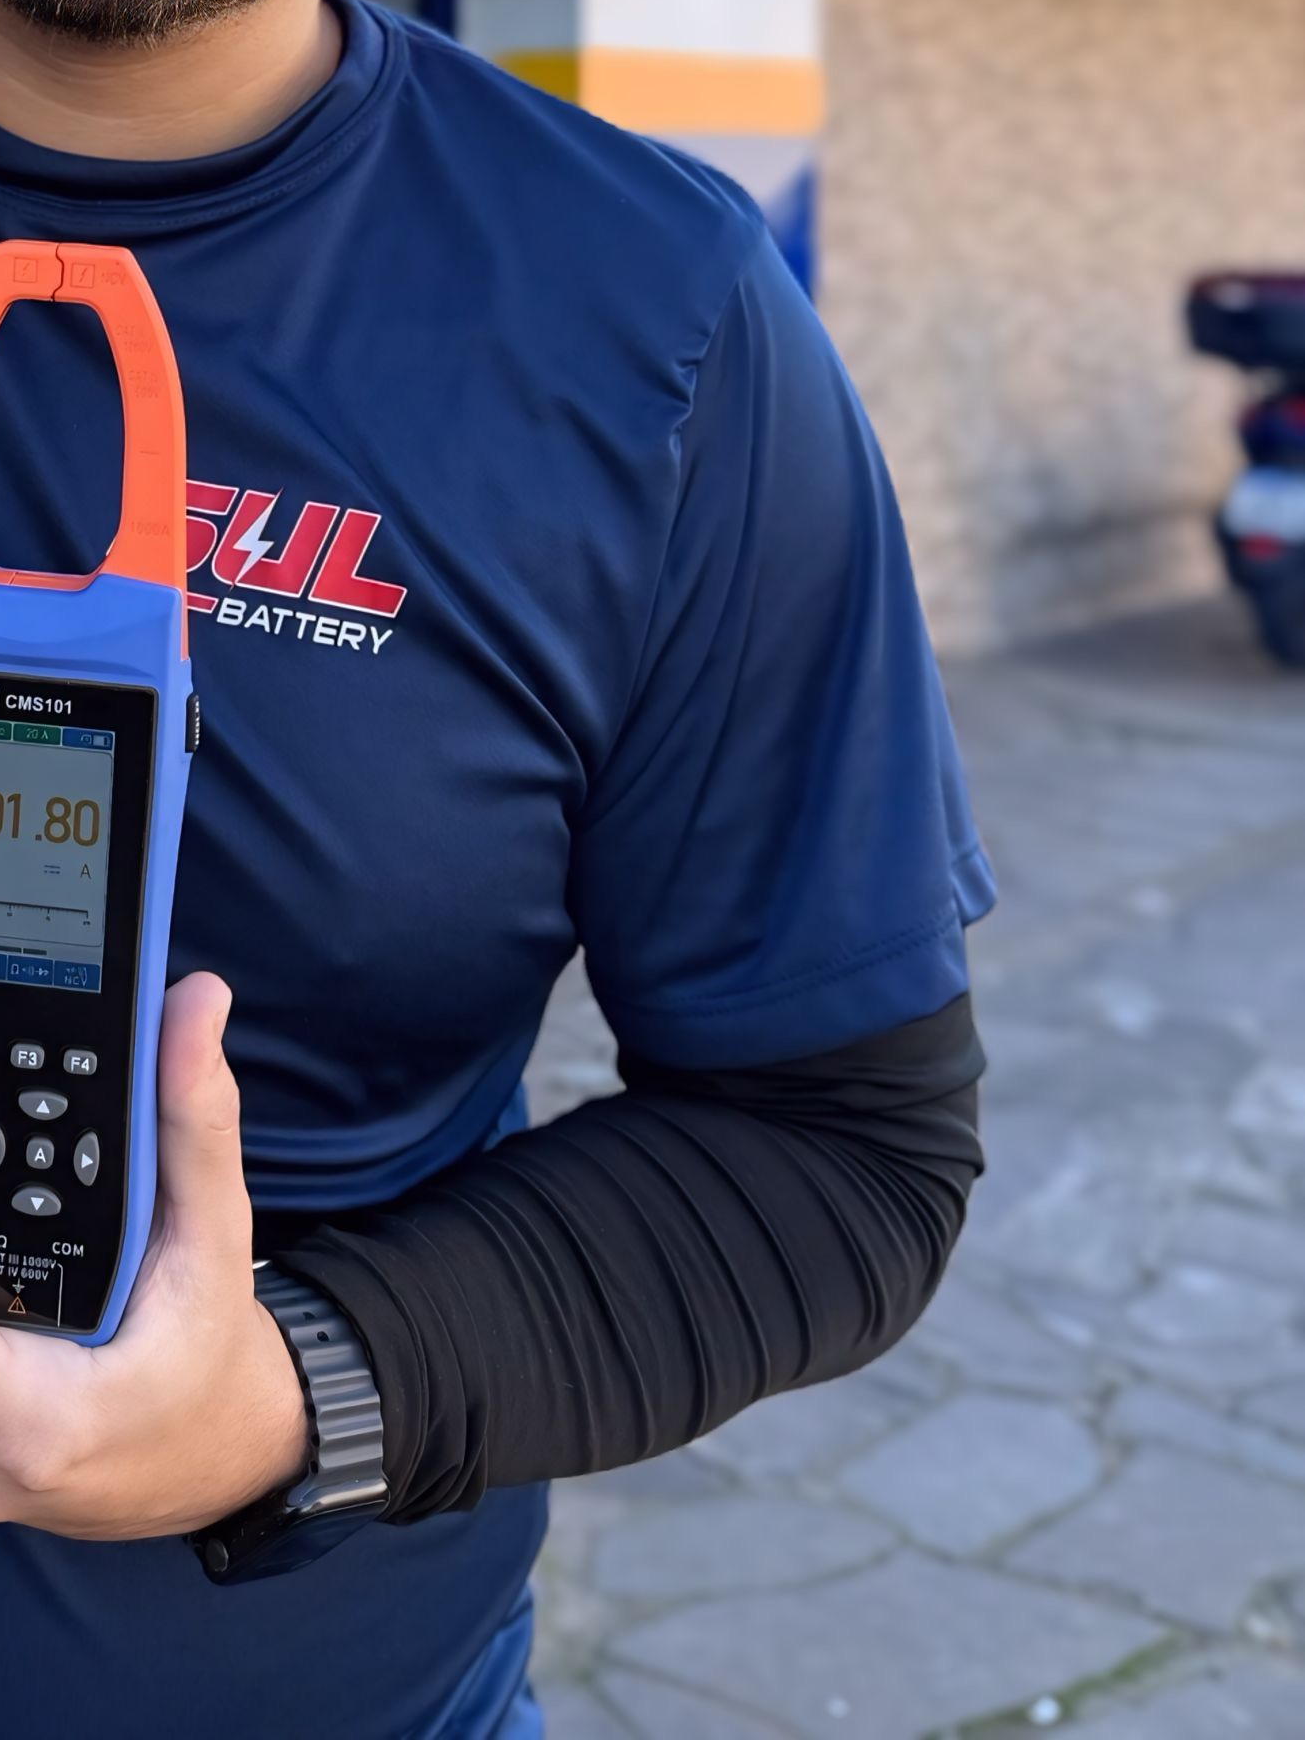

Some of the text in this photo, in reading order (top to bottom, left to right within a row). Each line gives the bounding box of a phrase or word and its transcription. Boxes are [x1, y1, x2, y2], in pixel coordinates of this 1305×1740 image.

[216, 597, 393, 655] BATTERY
[5, 694, 72, 715] CMS101
[80, 863, 92, 880] A
[18, 1051, 37, 1066] F3
[70, 1056, 90, 1072] F4
[34, 1147, 46, 1163] A
[52, 1241, 84, 1257] COM
